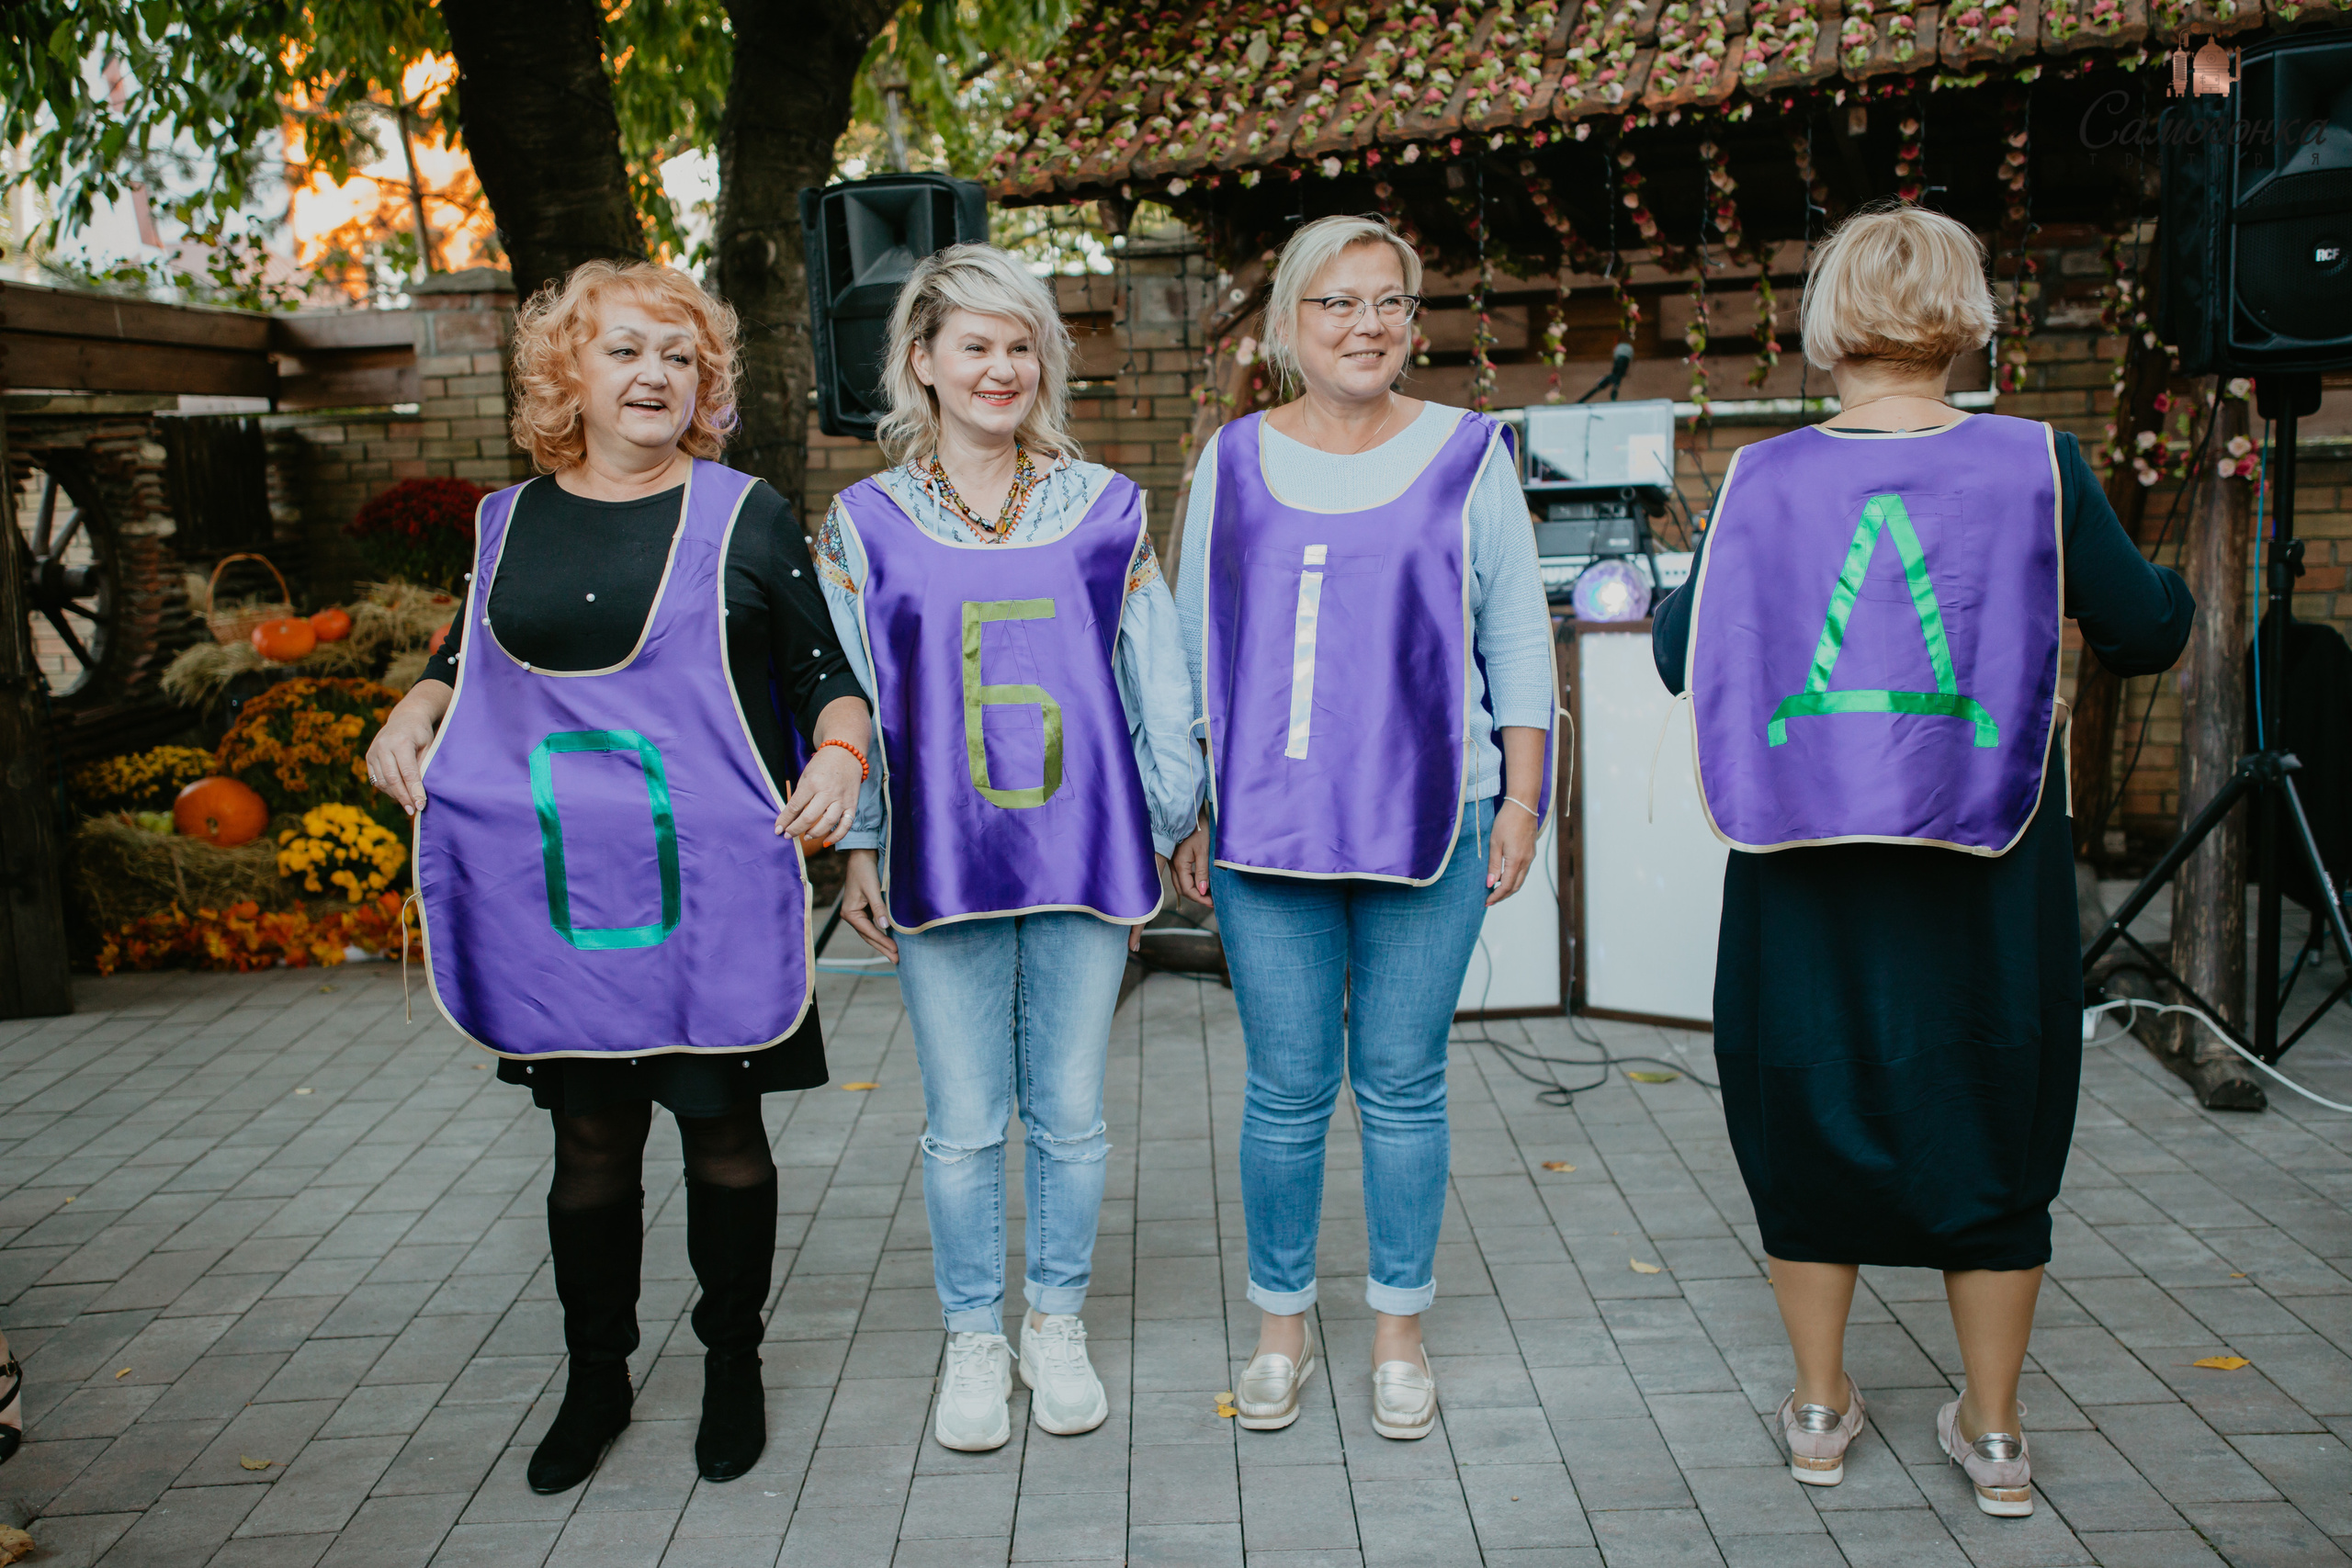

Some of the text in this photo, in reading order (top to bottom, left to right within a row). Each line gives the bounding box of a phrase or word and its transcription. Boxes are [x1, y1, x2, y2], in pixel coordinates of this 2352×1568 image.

[2315, 247, 2340, 263] RCF
[962, 598, 1063, 809] Б
[1768, 493, 1999, 748] Д
